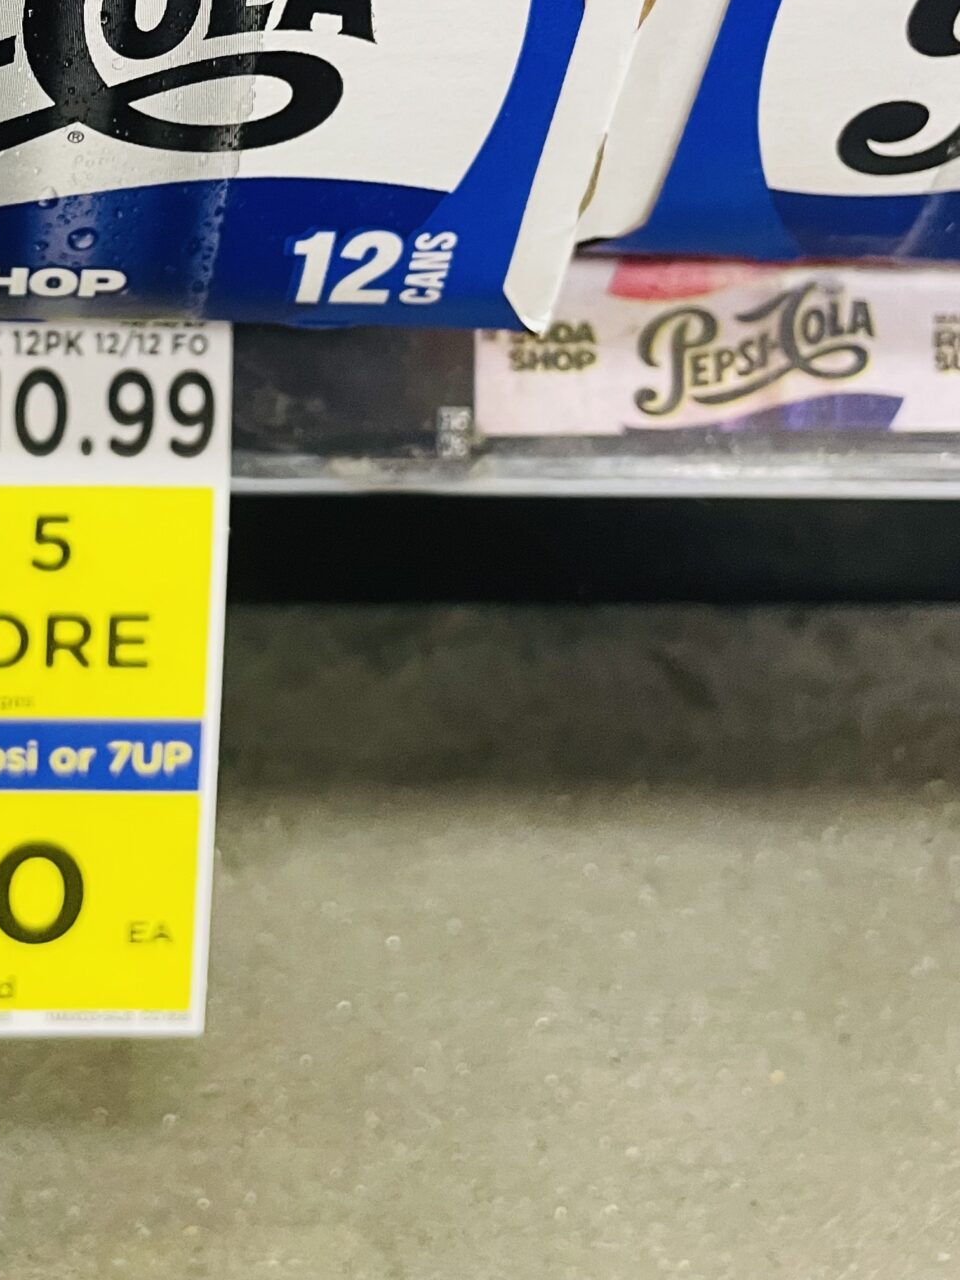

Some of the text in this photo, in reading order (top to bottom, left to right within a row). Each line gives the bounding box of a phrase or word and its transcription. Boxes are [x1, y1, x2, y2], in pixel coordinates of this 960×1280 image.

[293, 230, 404, 305] 12
[398, 231, 458, 305] CANS
[12, 329, 84, 357] 12PK
[94, 331, 162, 358] 12/12
[171, 333, 210, 357] FO
[509, 348, 597, 371] SHOP
[30, 513, 73, 572] 5
[49, 745, 96, 775] or
[107, 739, 194, 774] 7UP
[127, 921, 174, 944] EA
